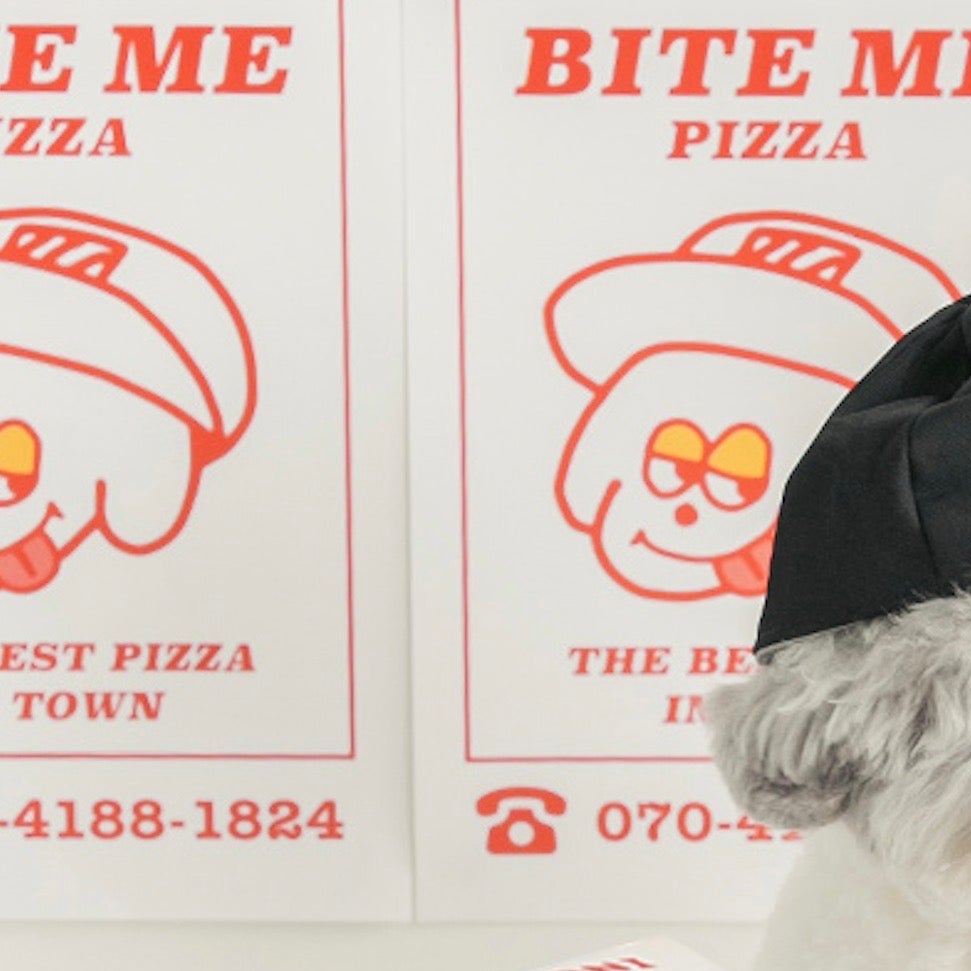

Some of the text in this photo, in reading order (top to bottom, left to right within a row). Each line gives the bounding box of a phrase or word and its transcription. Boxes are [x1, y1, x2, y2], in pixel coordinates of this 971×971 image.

[105, 26, 292, 94] ME
[516, 28, 816, 96] BITE
[0, 117, 130, 156] ZZA
[669, 121, 864, 160] PIZZA
[114, 644, 253, 671] PIZZA
[571, 647, 762, 675] THE BE
[14, 692, 163, 720] TOWN
[597, 801, 798, 842] 070-4
